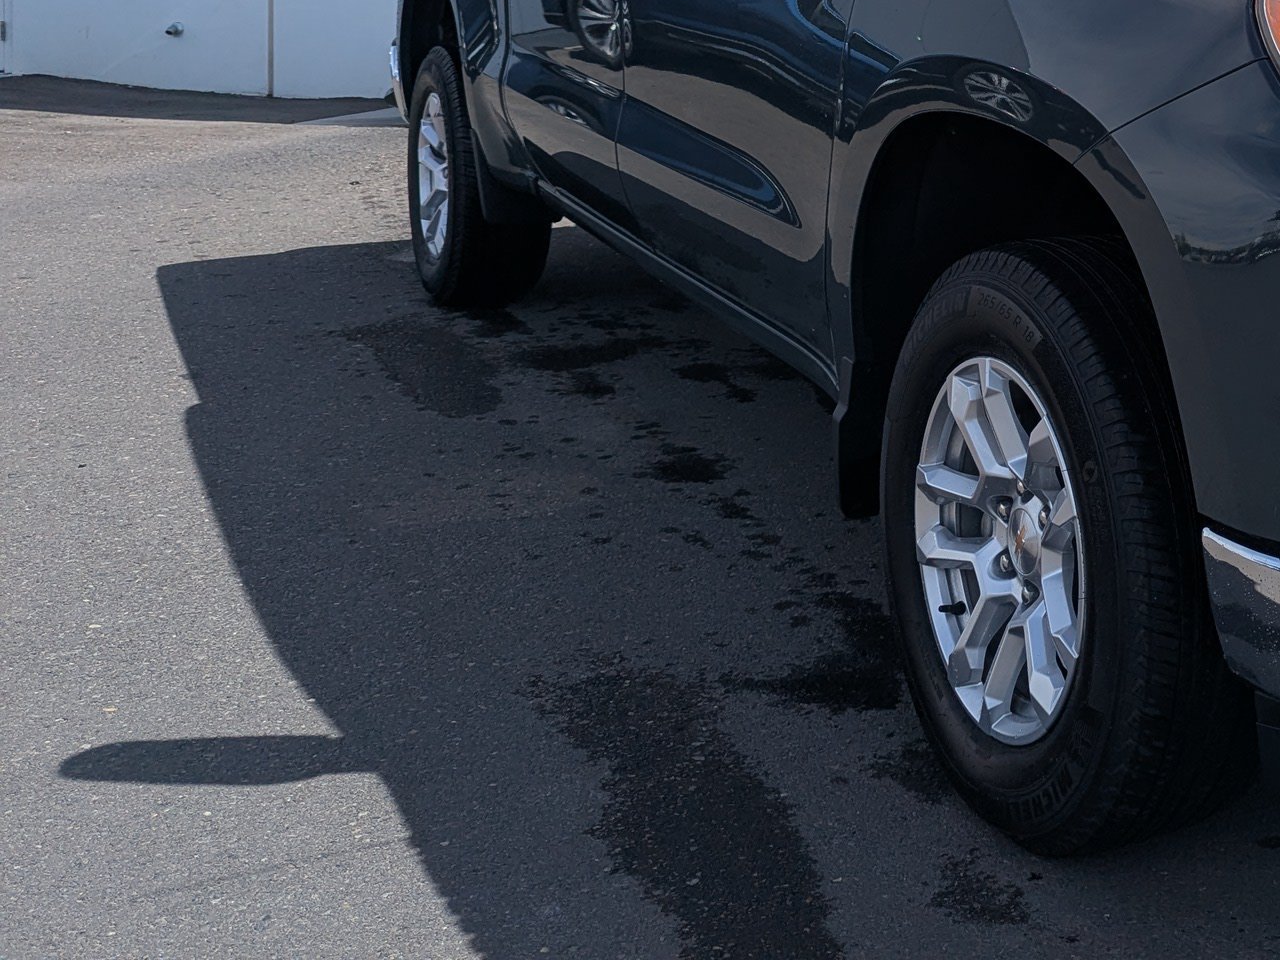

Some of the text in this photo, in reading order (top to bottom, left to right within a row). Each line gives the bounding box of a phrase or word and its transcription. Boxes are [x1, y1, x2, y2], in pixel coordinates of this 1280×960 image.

[978, 293, 1036, 342] 265/65 R 18
